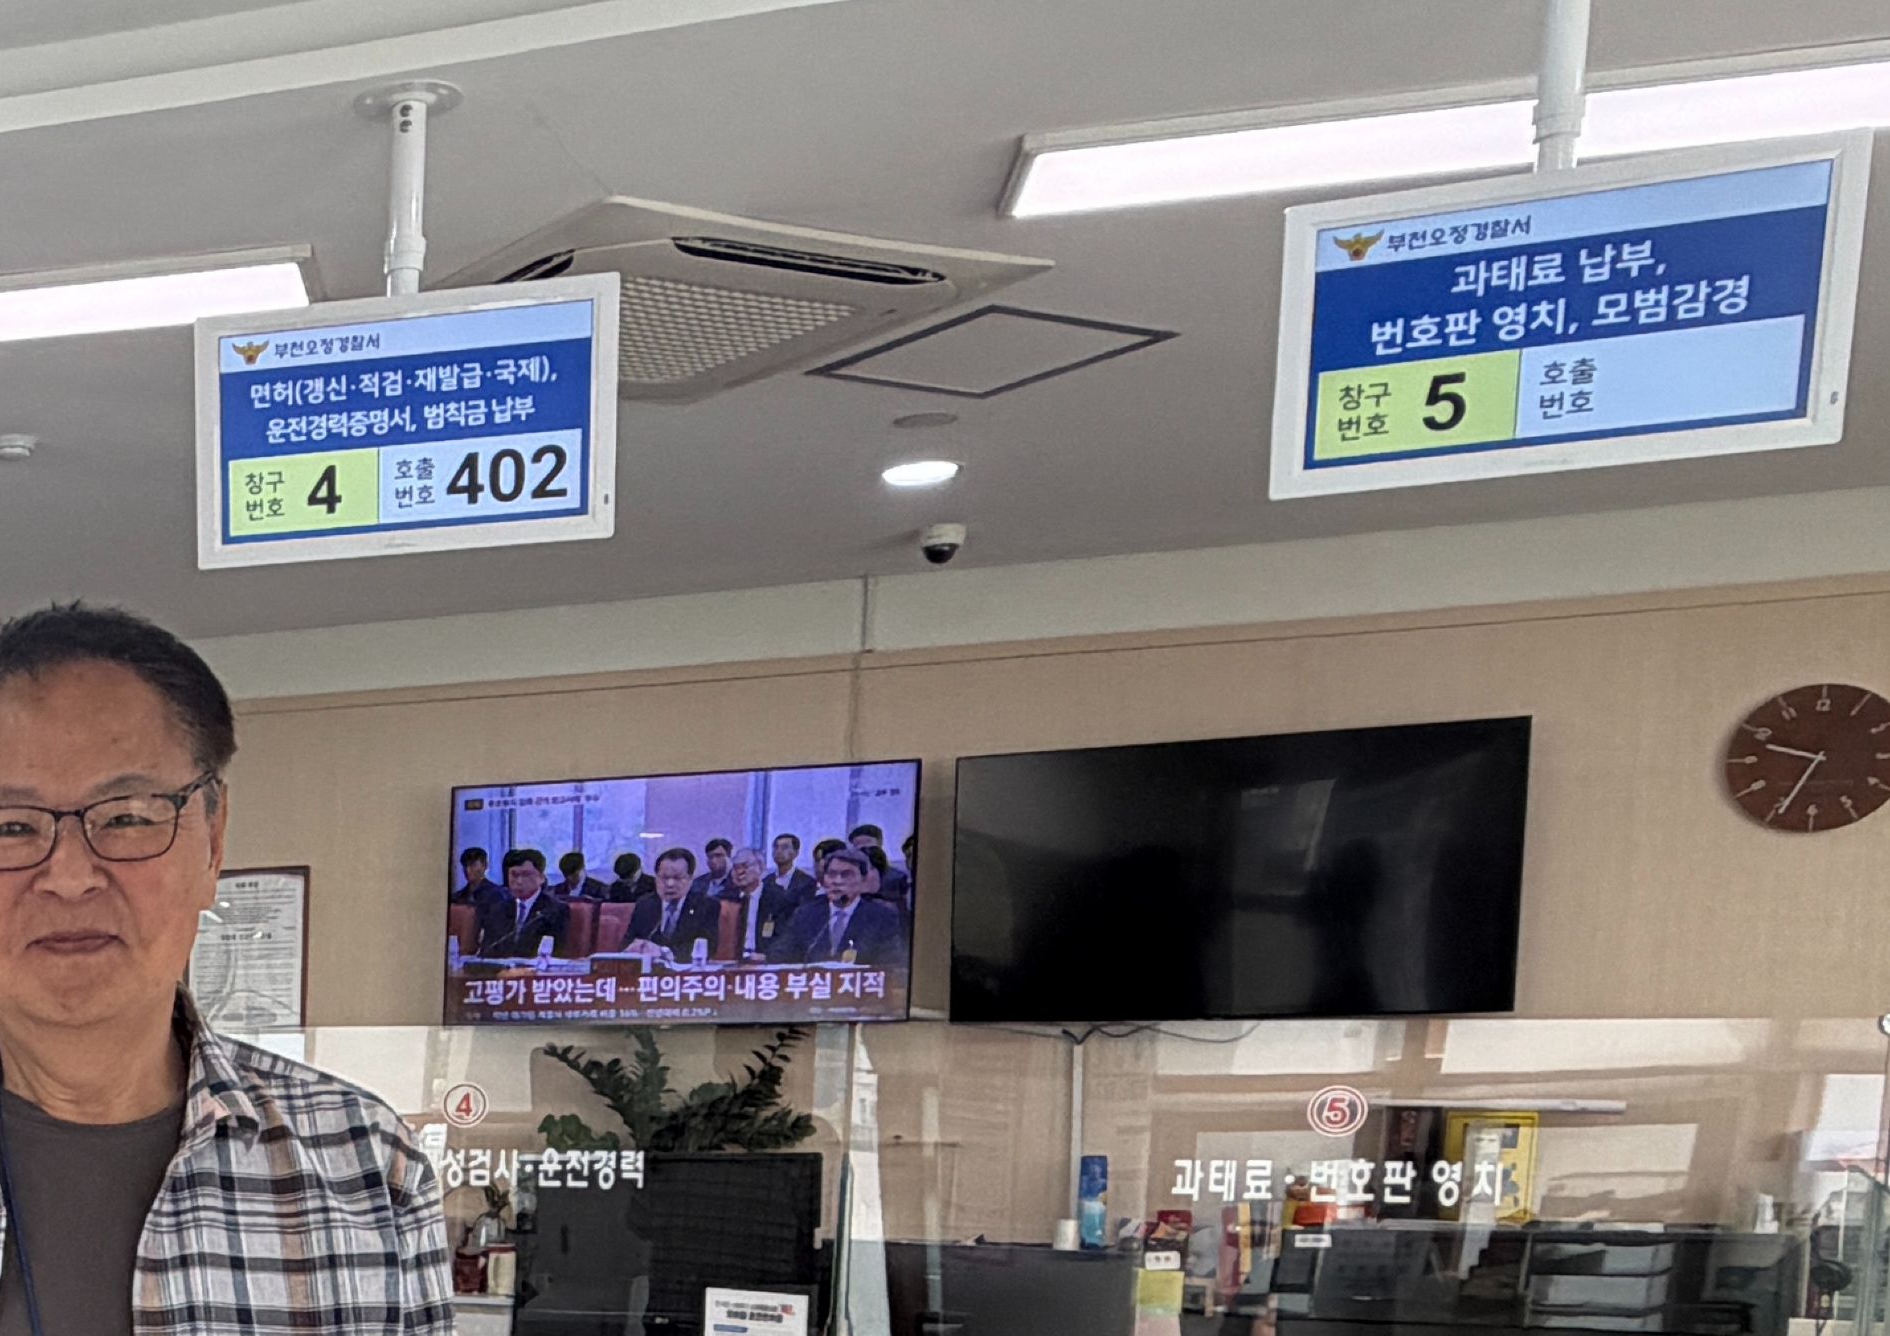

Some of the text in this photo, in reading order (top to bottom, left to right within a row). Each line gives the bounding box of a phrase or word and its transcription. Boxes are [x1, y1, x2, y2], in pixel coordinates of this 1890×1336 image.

[1451, 240, 1666, 297] 과태료 납부,
[1371, 276, 1749, 355] 번호판 영치, 모범감경
[1541, 358, 1597, 385] 호출
[1339, 382, 1391, 407] 창구
[1423, 373, 1466, 430] 5
[1540, 390, 1594, 418] 번호
[266, 397, 534, 444] 운전경력증명서, 범칙금 납부
[1338, 414, 1389, 441] 번호
[246, 471, 284, 495] 창구
[395, 458, 435, 481] 호출
[447, 445, 567, 504] 402
[307, 465, 342, 514] 4
[395, 486, 435, 508] 번호
[246, 499, 284, 520] 번호
[463, 980, 527, 1005] 고평가
[785, 973, 832, 997] 부실
[837, 972, 885, 995] 지적
[454, 1091, 473, 1117] 4
[1323, 1093, 1351, 1127] 5
[1432, 1159, 1503, 1205] 영치
